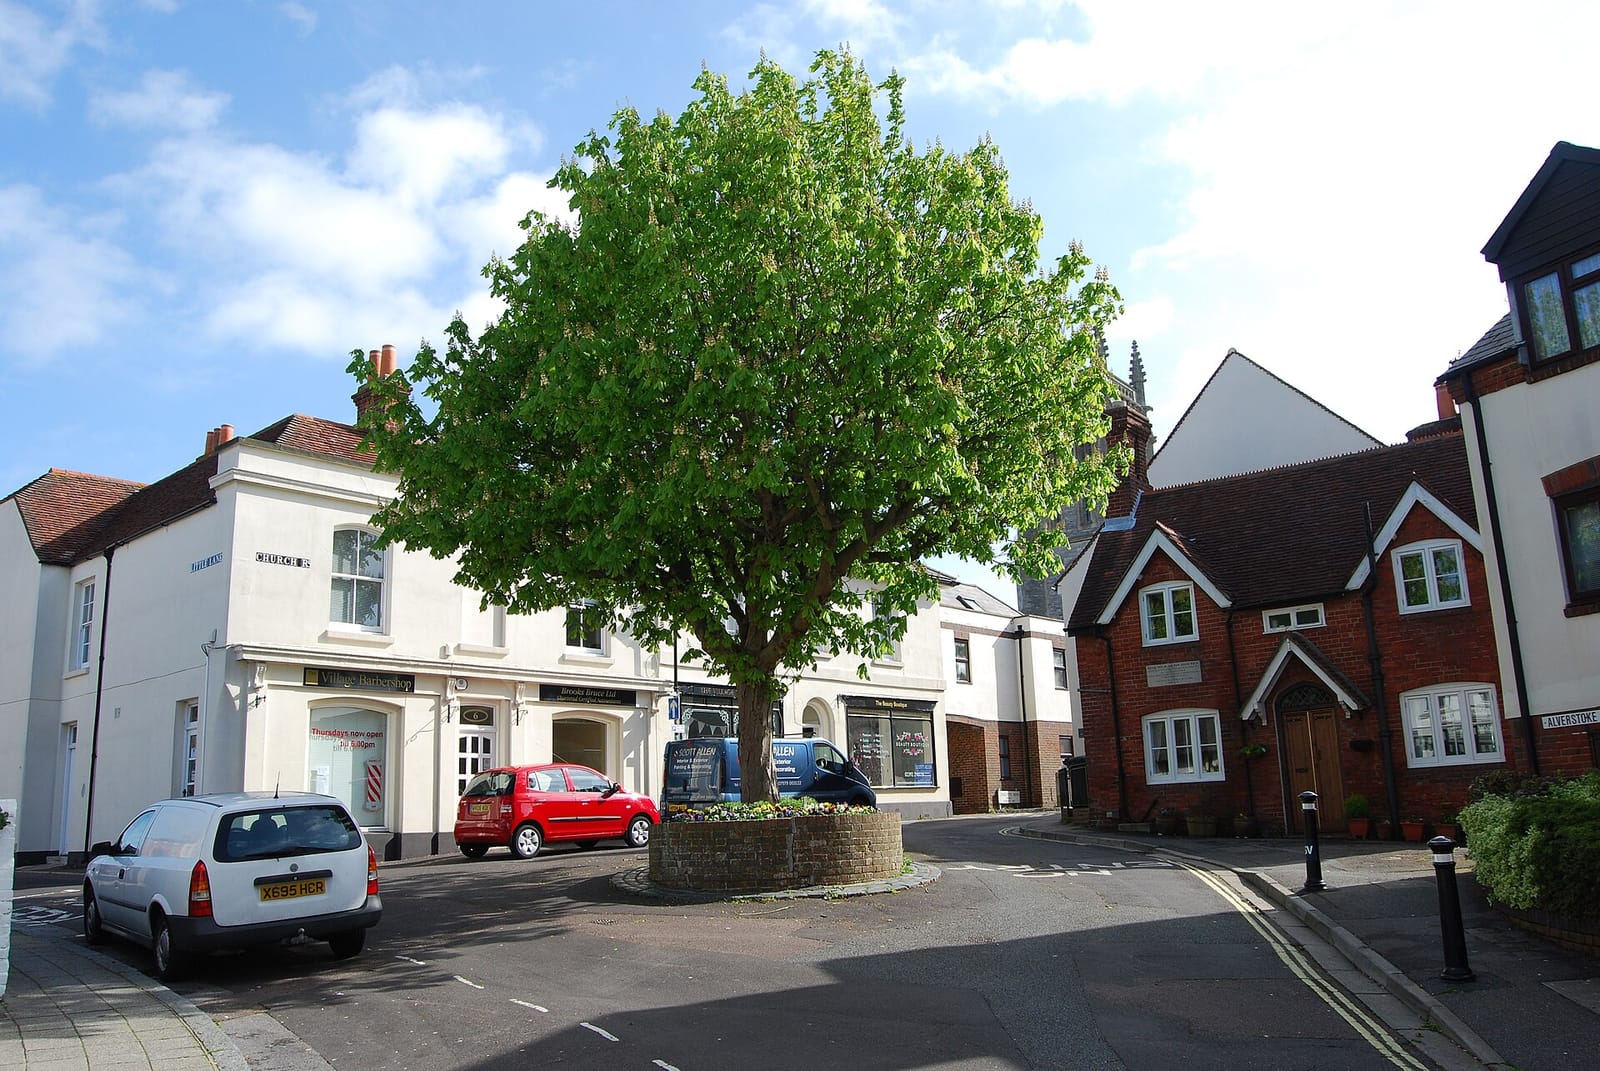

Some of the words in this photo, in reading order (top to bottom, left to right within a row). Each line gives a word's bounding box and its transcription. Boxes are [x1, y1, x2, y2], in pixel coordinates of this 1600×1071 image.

[257, 553, 297, 566] CHURCH
[322, 671, 355, 685] Village
[360, 675, 412, 689] Barbershop
[561, 687, 584, 696] Brooks
[586, 689, 604, 697] Bruce
[606, 690, 617, 698] Ltd
[473, 711, 479, 720] 6
[1547, 712, 1597, 727] ALVERSTOKE
[312, 728, 349, 738] Thursdays
[350, 740, 376, 749] 6.00pm
[679, 747, 696, 757] SCOTT
[696, 747, 716, 756] ALLEN
[263, 885, 297, 899] X695
[300, 881, 324, 895] HCR
